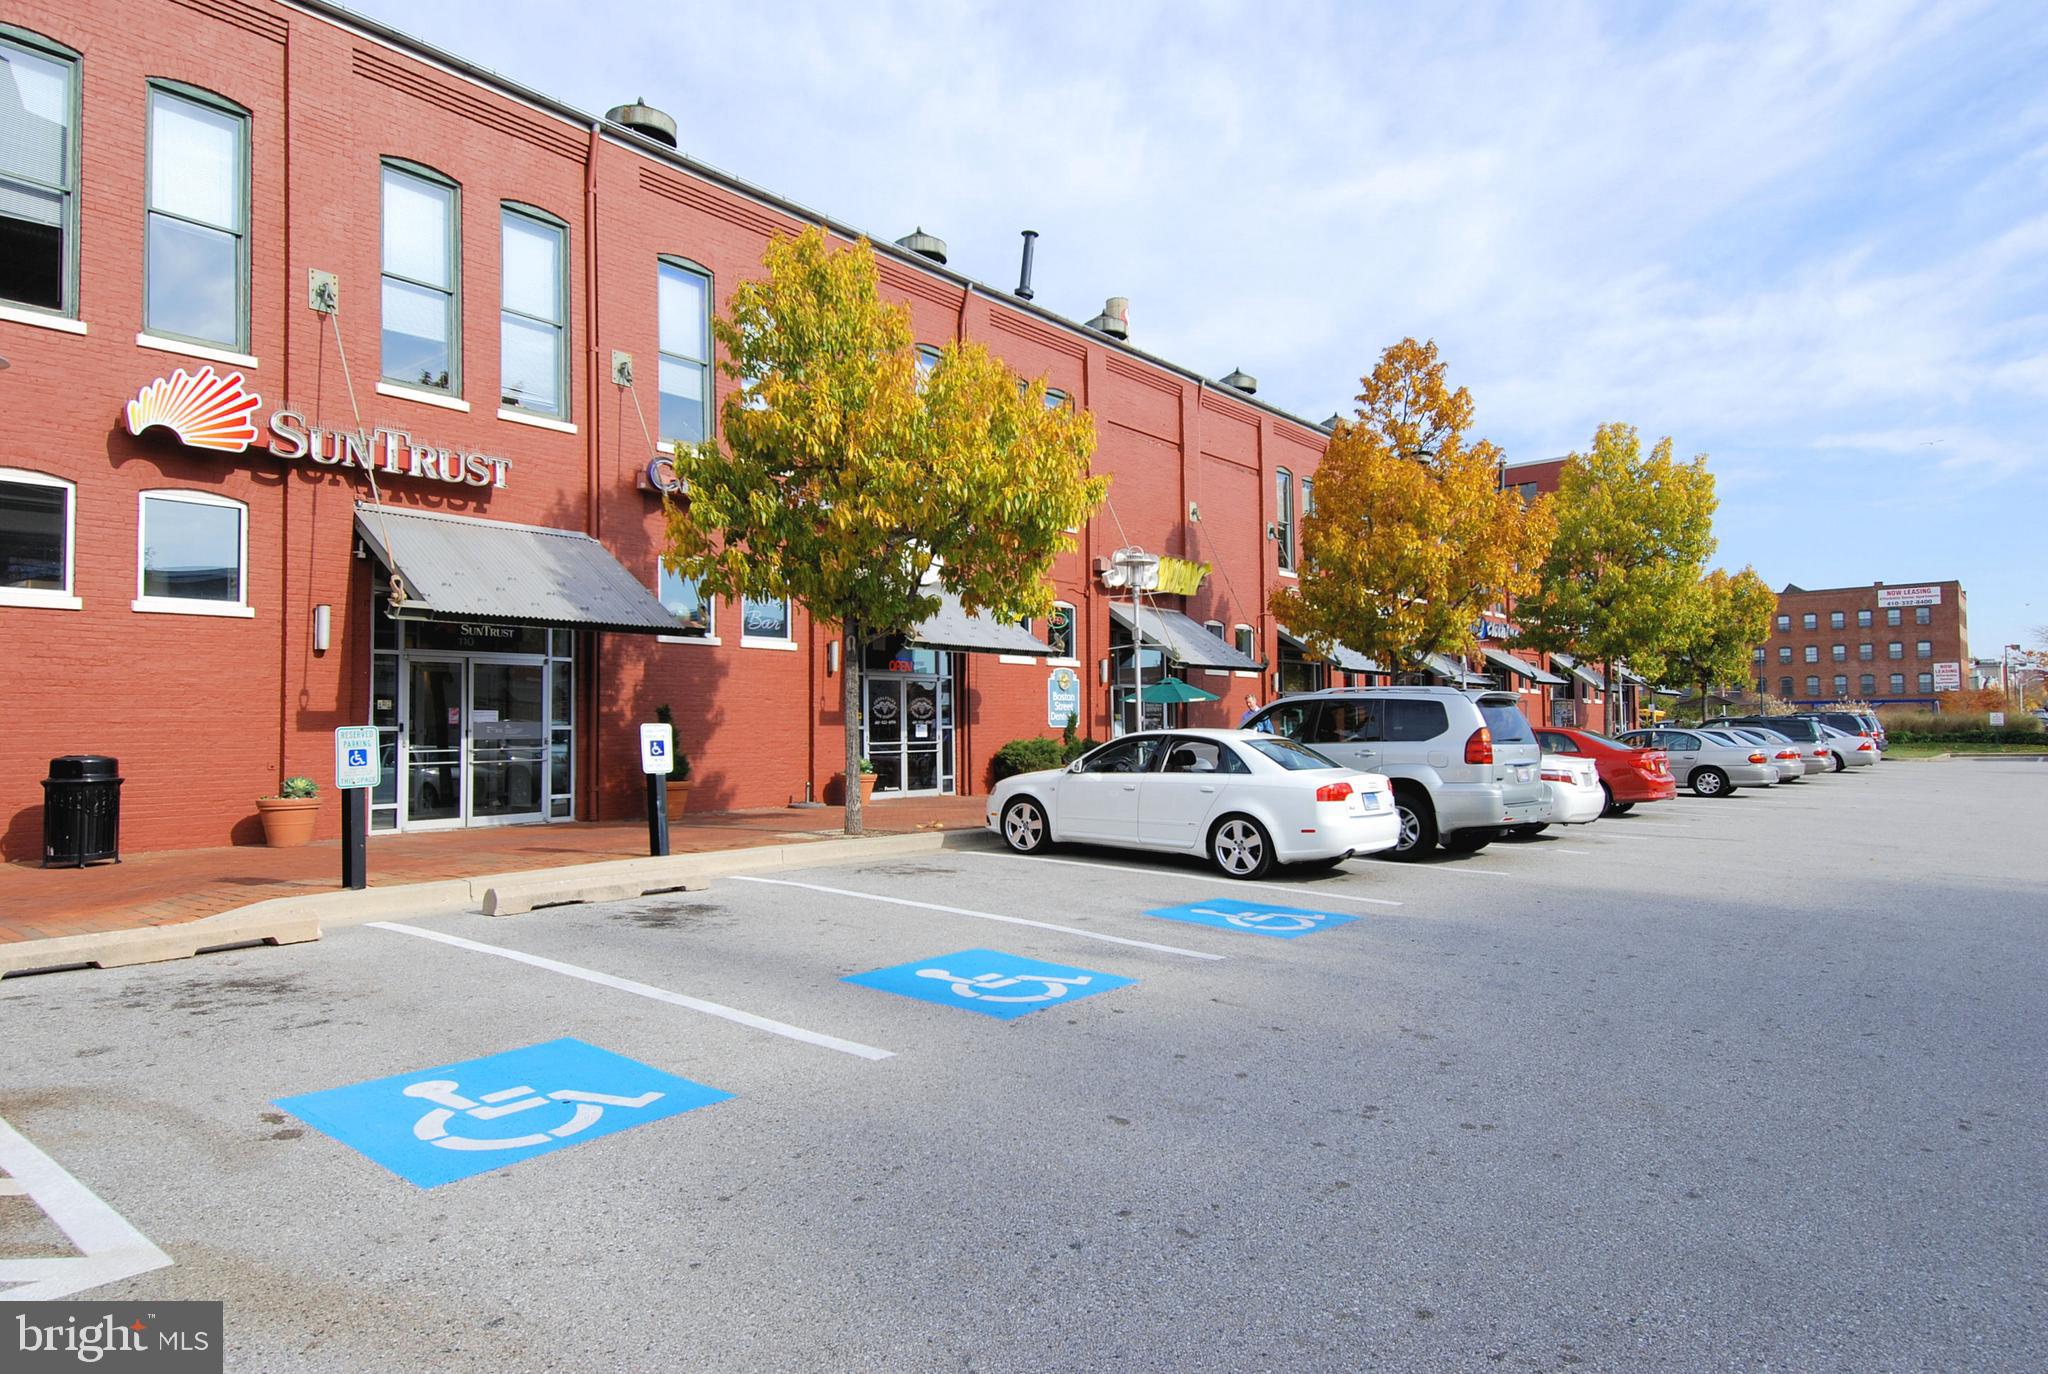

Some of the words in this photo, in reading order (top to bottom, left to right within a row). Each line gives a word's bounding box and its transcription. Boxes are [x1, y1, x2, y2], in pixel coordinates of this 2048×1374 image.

[748, 610, 780, 630] Bar
[889, 660, 913, 672] OPEN
[1053, 692, 1075, 701] Boston
[1054, 702, 1074, 711] Street
[340, 730, 374, 739] RESERVED
